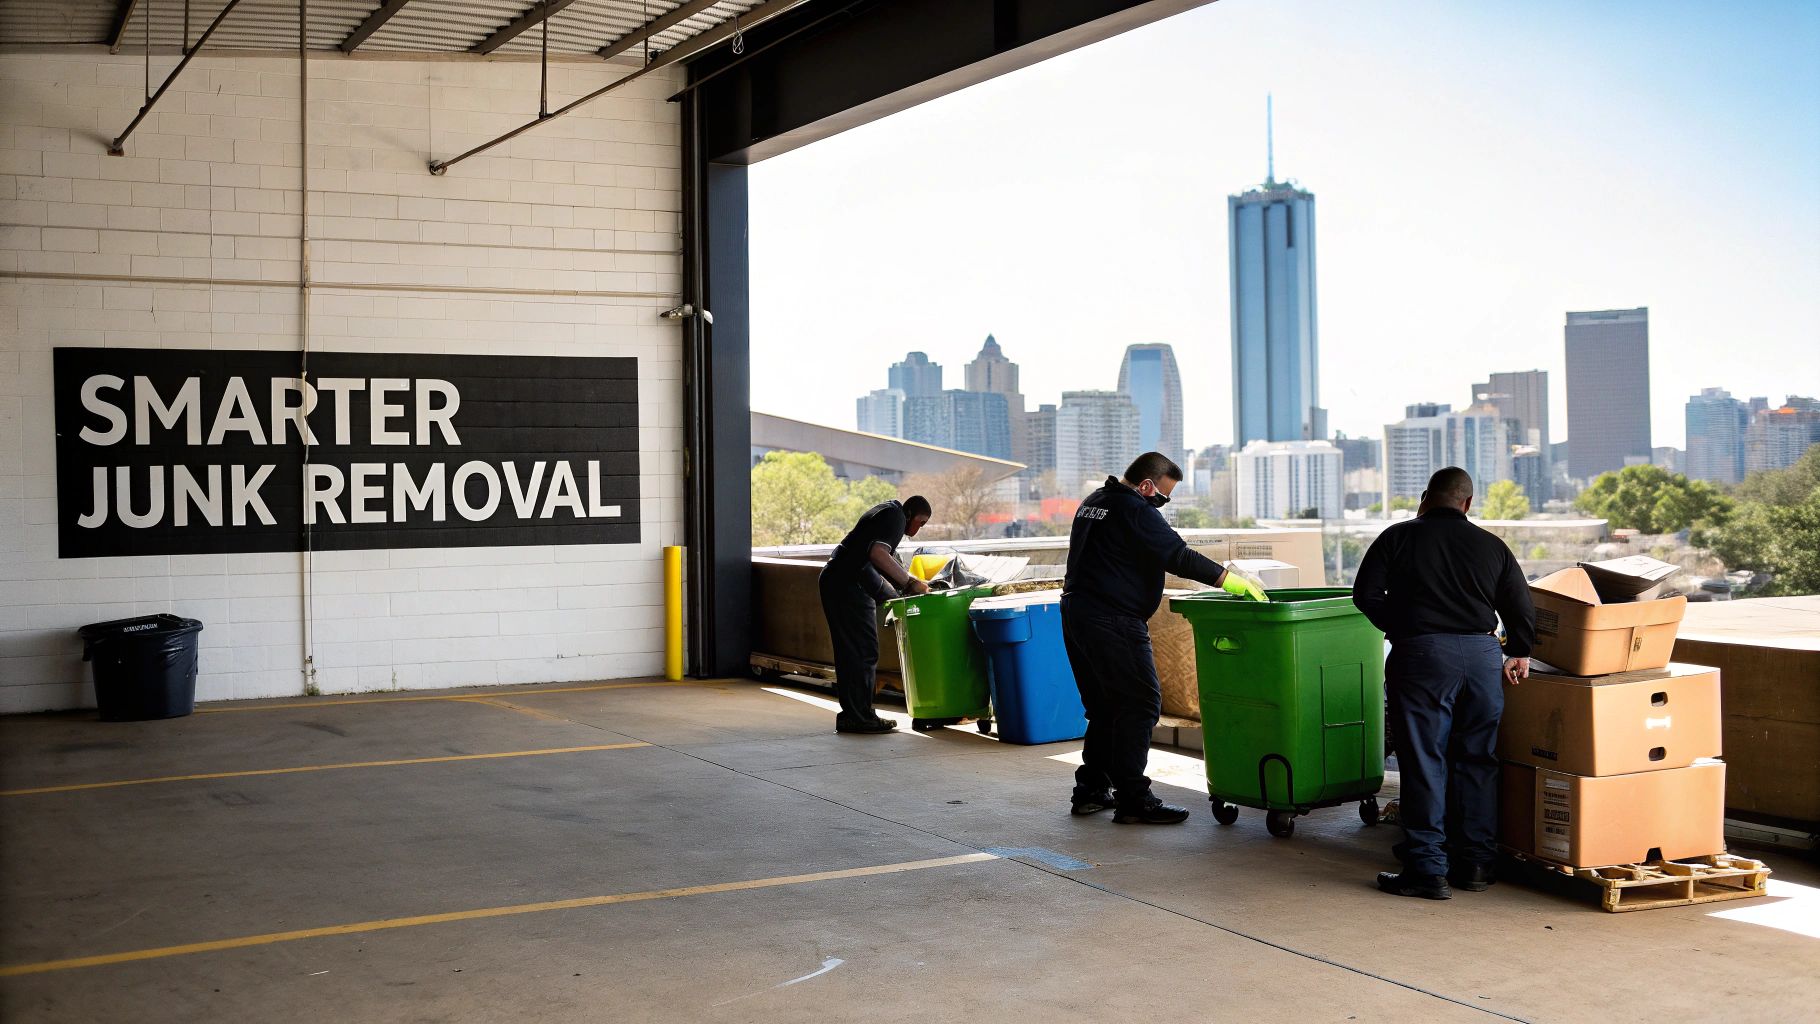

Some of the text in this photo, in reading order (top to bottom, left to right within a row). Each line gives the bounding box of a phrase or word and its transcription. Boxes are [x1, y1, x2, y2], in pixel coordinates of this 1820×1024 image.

[79, 374, 462, 446] SMARTER
[77, 460, 622, 528] JUNK REMOVAL
